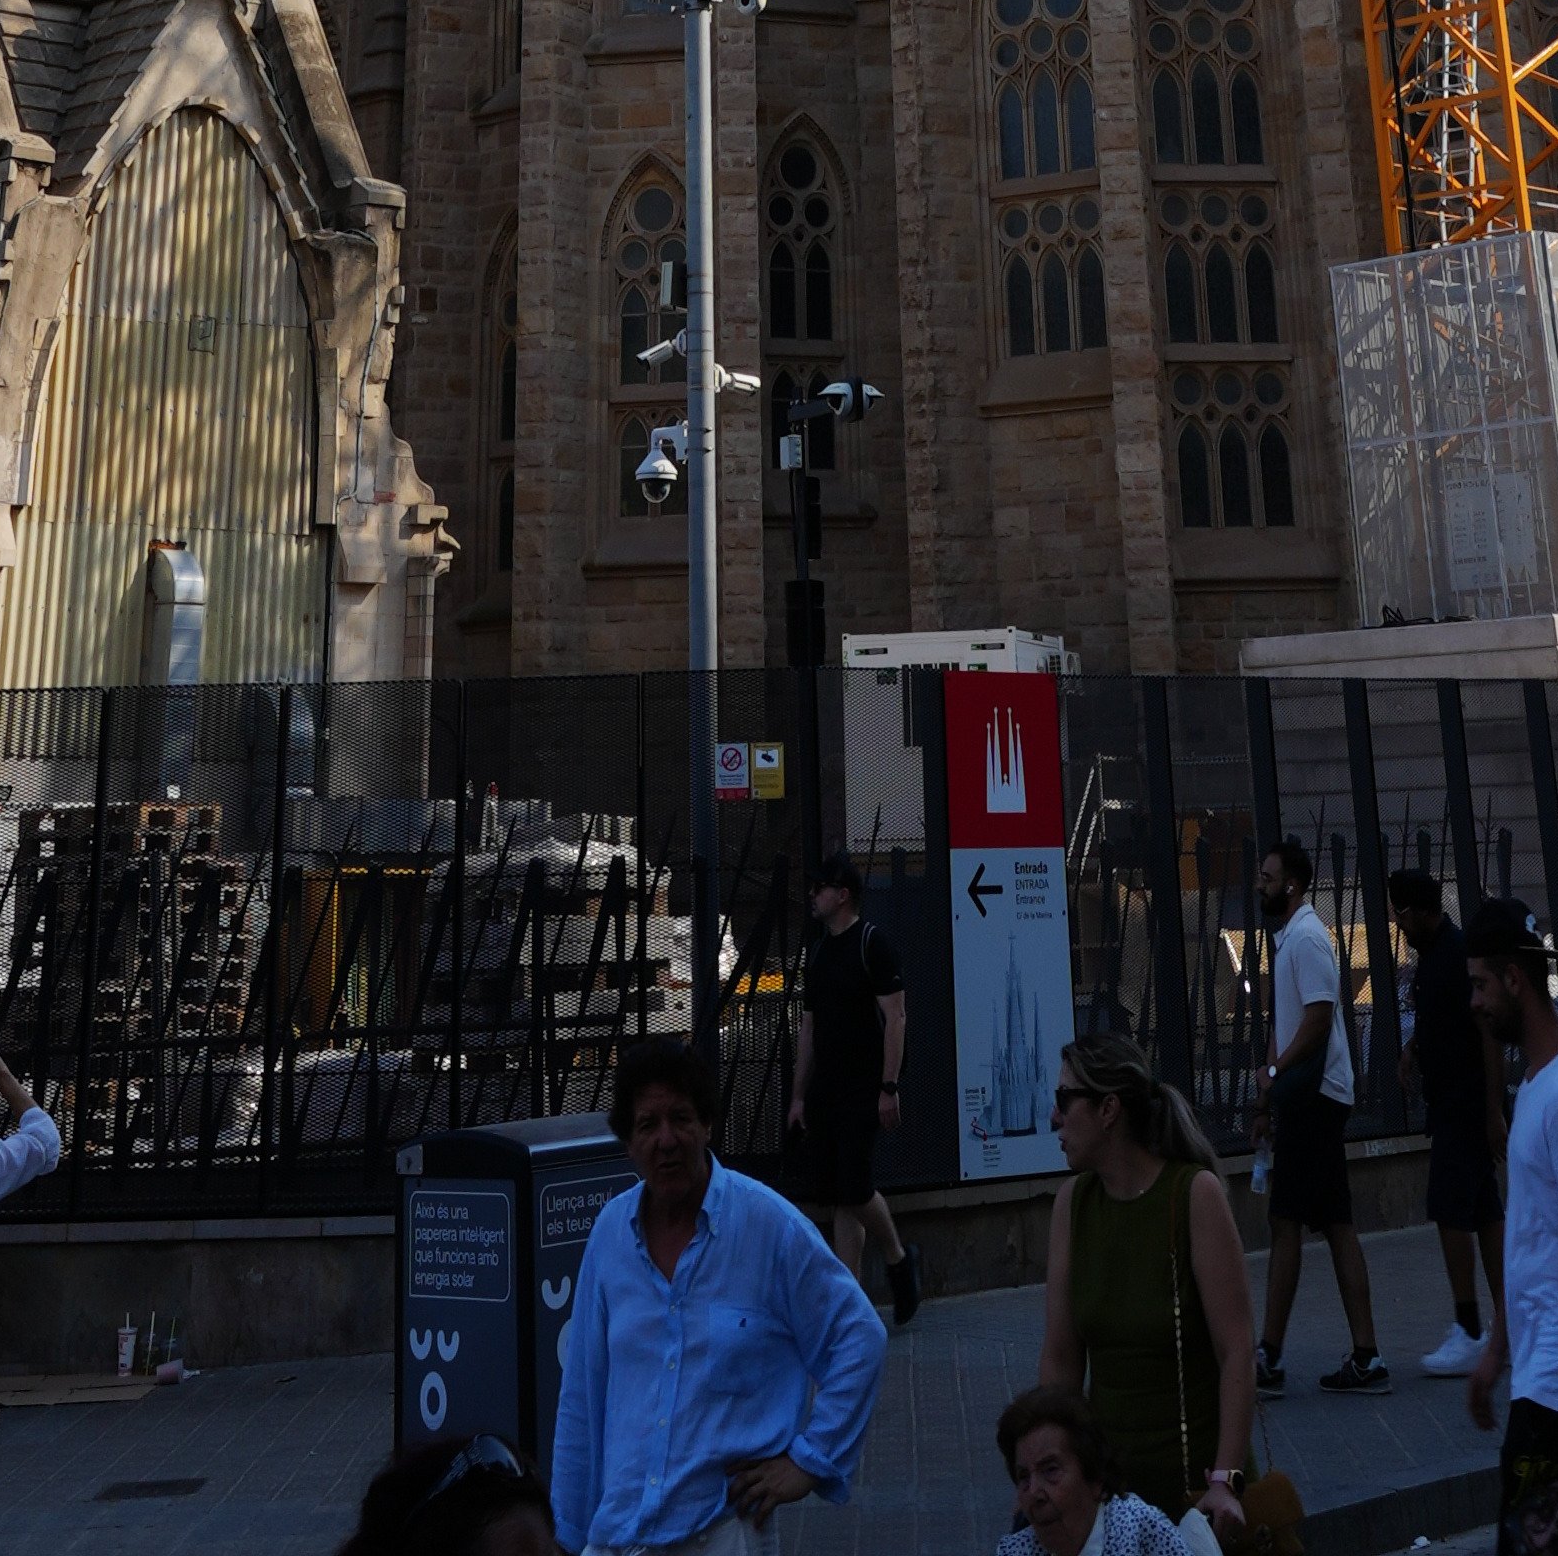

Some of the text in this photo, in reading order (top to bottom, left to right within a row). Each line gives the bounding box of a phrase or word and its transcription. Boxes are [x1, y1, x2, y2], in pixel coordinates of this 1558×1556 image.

[1015, 861, 1048, 874] Entrada
[1015, 879, 1050, 891] ENTRADA
[1016, 894, 1045, 905] Entrance
[415, 1202, 469, 1220] Això és una
[546, 1196, 585, 1214] Llença
[415, 1227, 458, 1244] paperera
[546, 1216, 592, 1237] els teus
[415, 1247, 500, 1267] que funciona amb
[415, 1271, 476, 1291] energia solar
